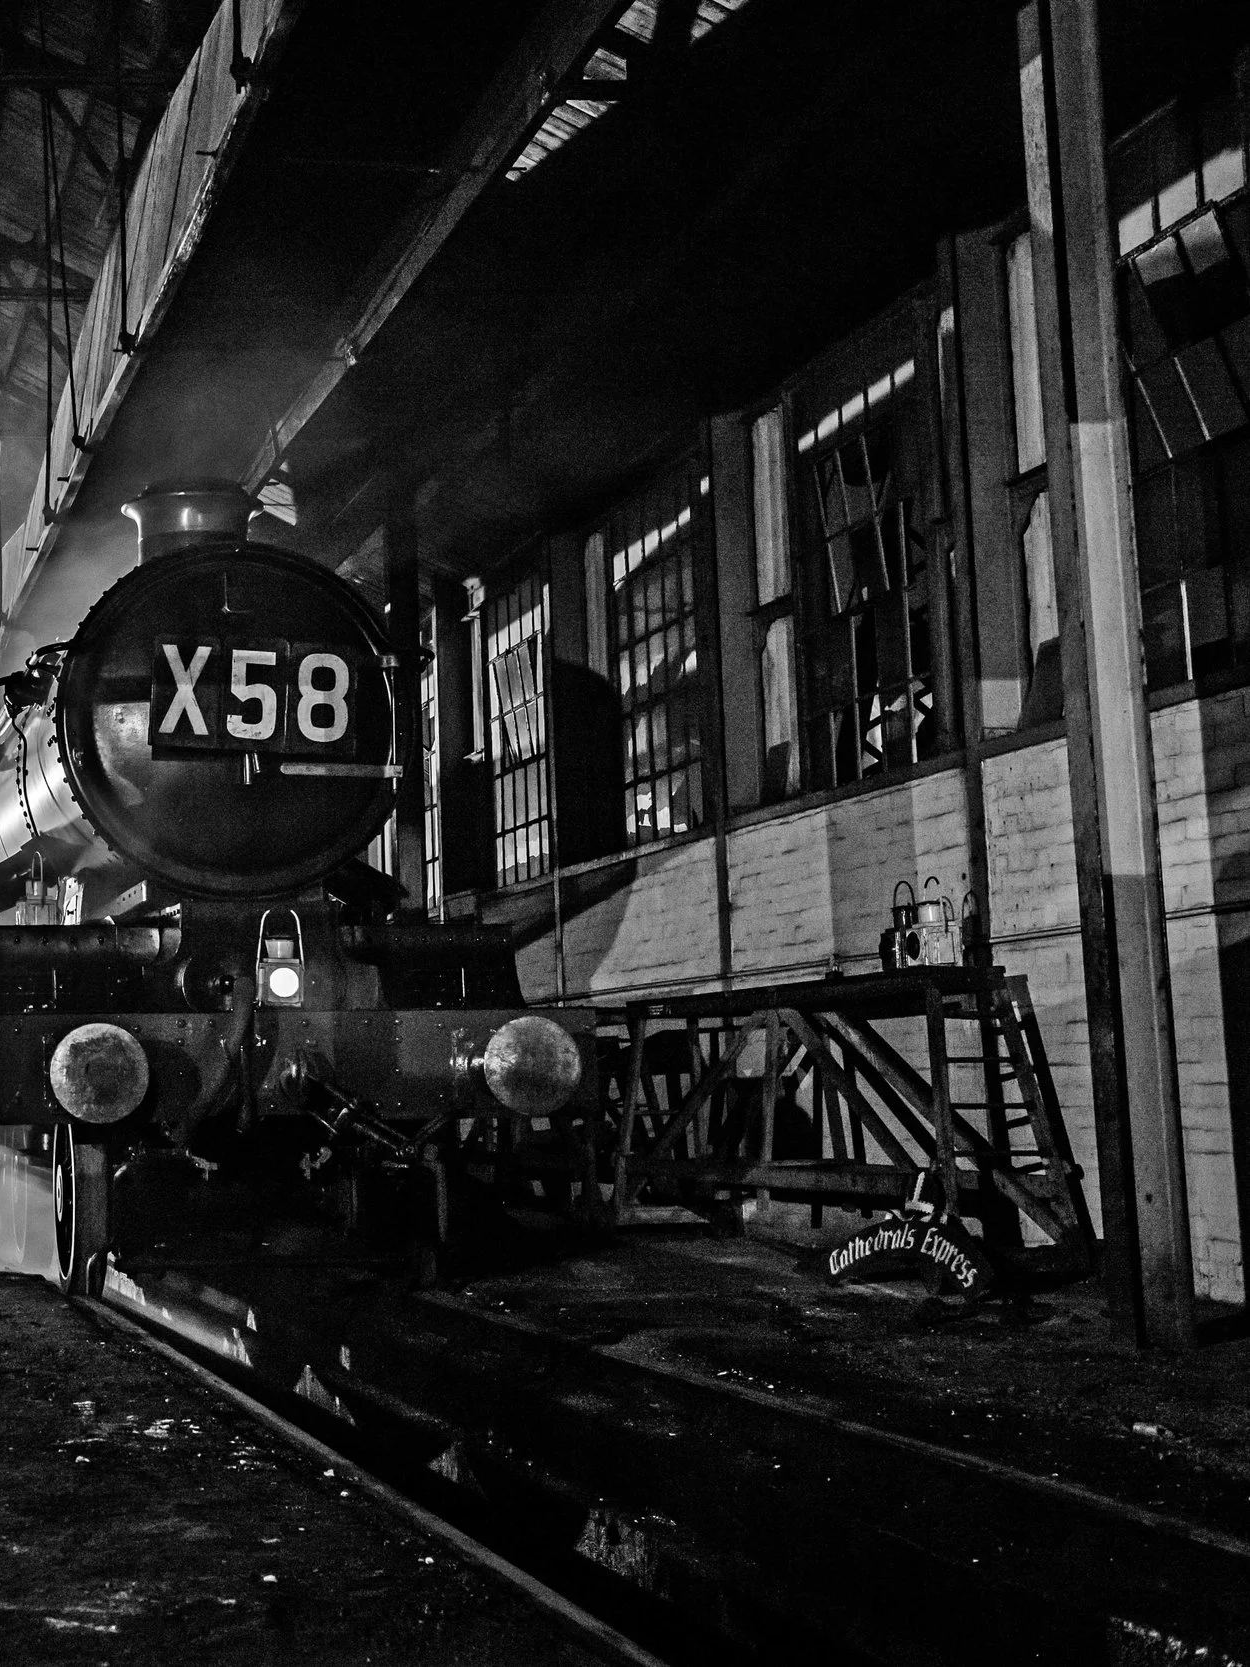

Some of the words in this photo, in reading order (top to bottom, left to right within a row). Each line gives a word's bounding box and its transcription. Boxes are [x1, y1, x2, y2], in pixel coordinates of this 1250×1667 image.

[158, 644, 350, 742] X58
[829, 1223, 917, 1275] Cathedrals
[920, 1227, 978, 1288] Express
